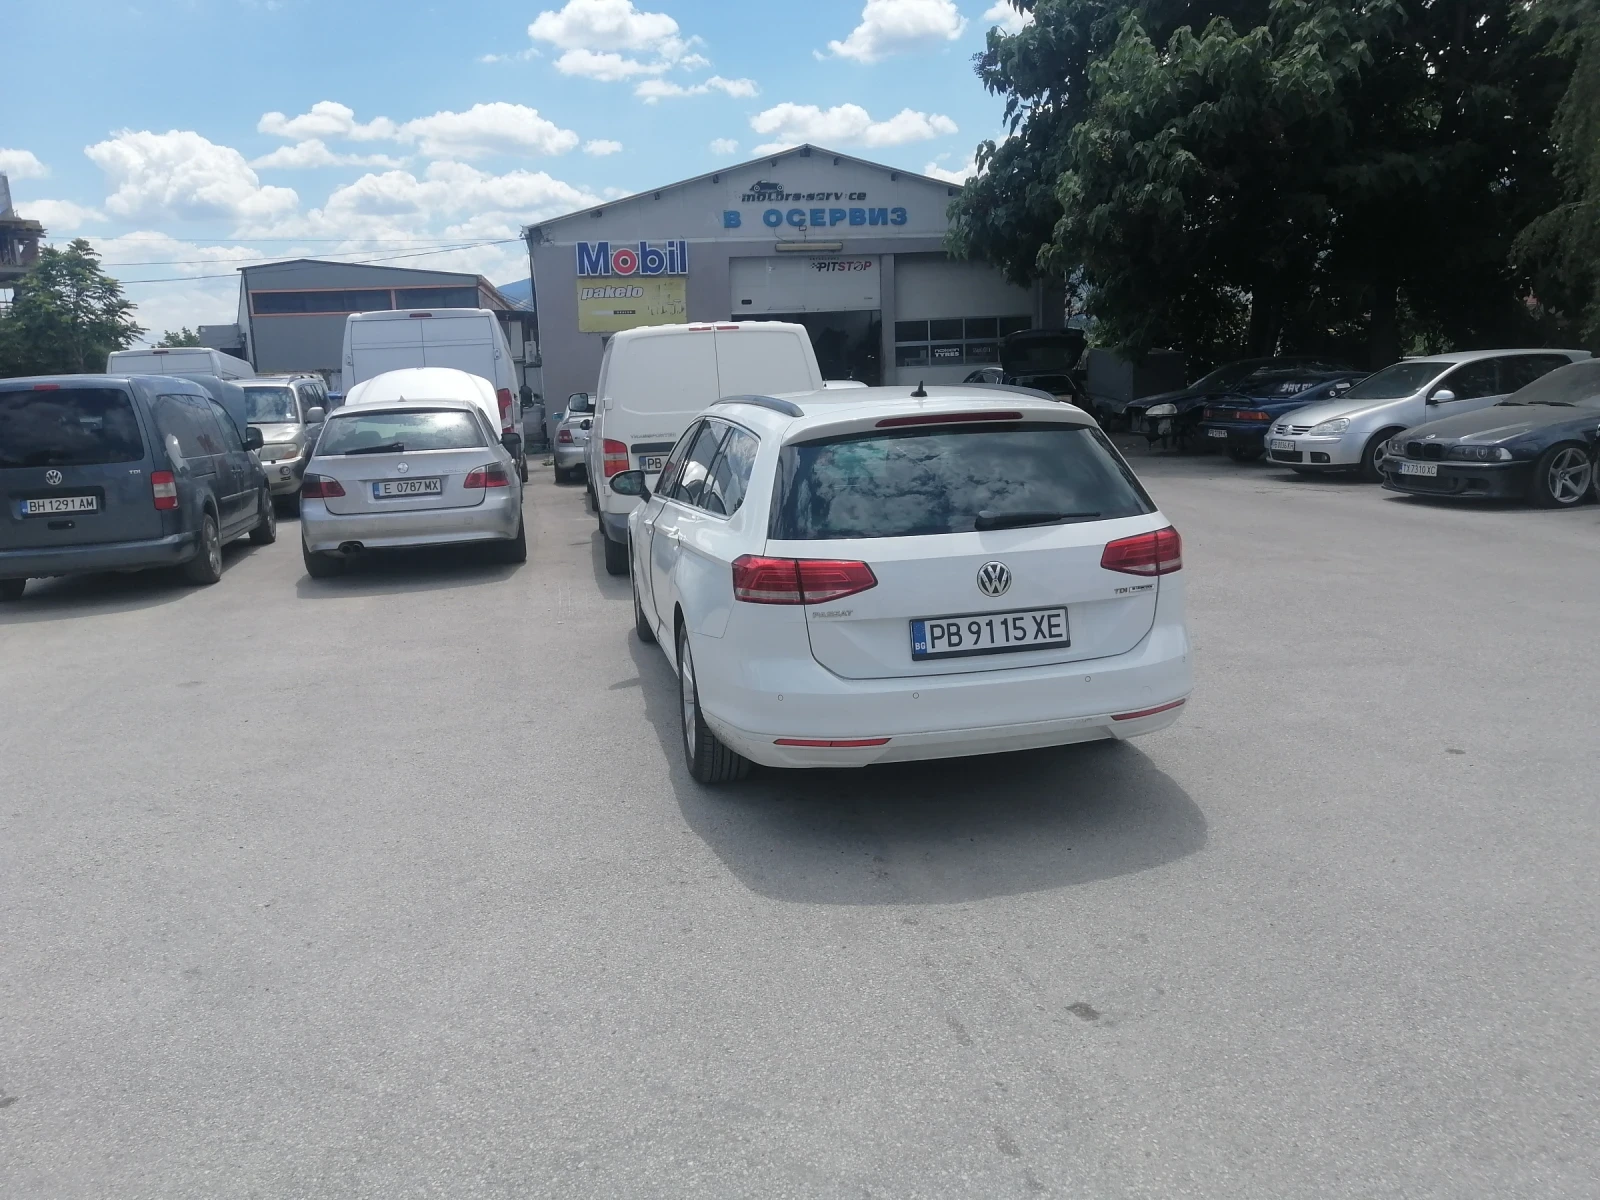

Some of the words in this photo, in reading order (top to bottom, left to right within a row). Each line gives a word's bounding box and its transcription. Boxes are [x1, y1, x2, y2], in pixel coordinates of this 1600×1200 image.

[575, 240, 689, 276] Mobil
[817, 261, 872, 272] PITSTOP
[581, 285, 643, 300] pakelo
[647, 457, 662, 469] PB
[384, 483, 392, 494] E
[396, 481, 422, 493] 0787
[424, 480, 439, 491] MX
[29, 500, 45, 512] BH
[49, 499, 76, 511] 1291
[79, 498, 95, 509] AM
[1114, 587, 1128, 595] TDI
[929, 622, 963, 649] PB
[967, 616, 1027, 646] 9115
[1032, 613, 1063, 640] XE
[915, 642, 926, 650] BG
